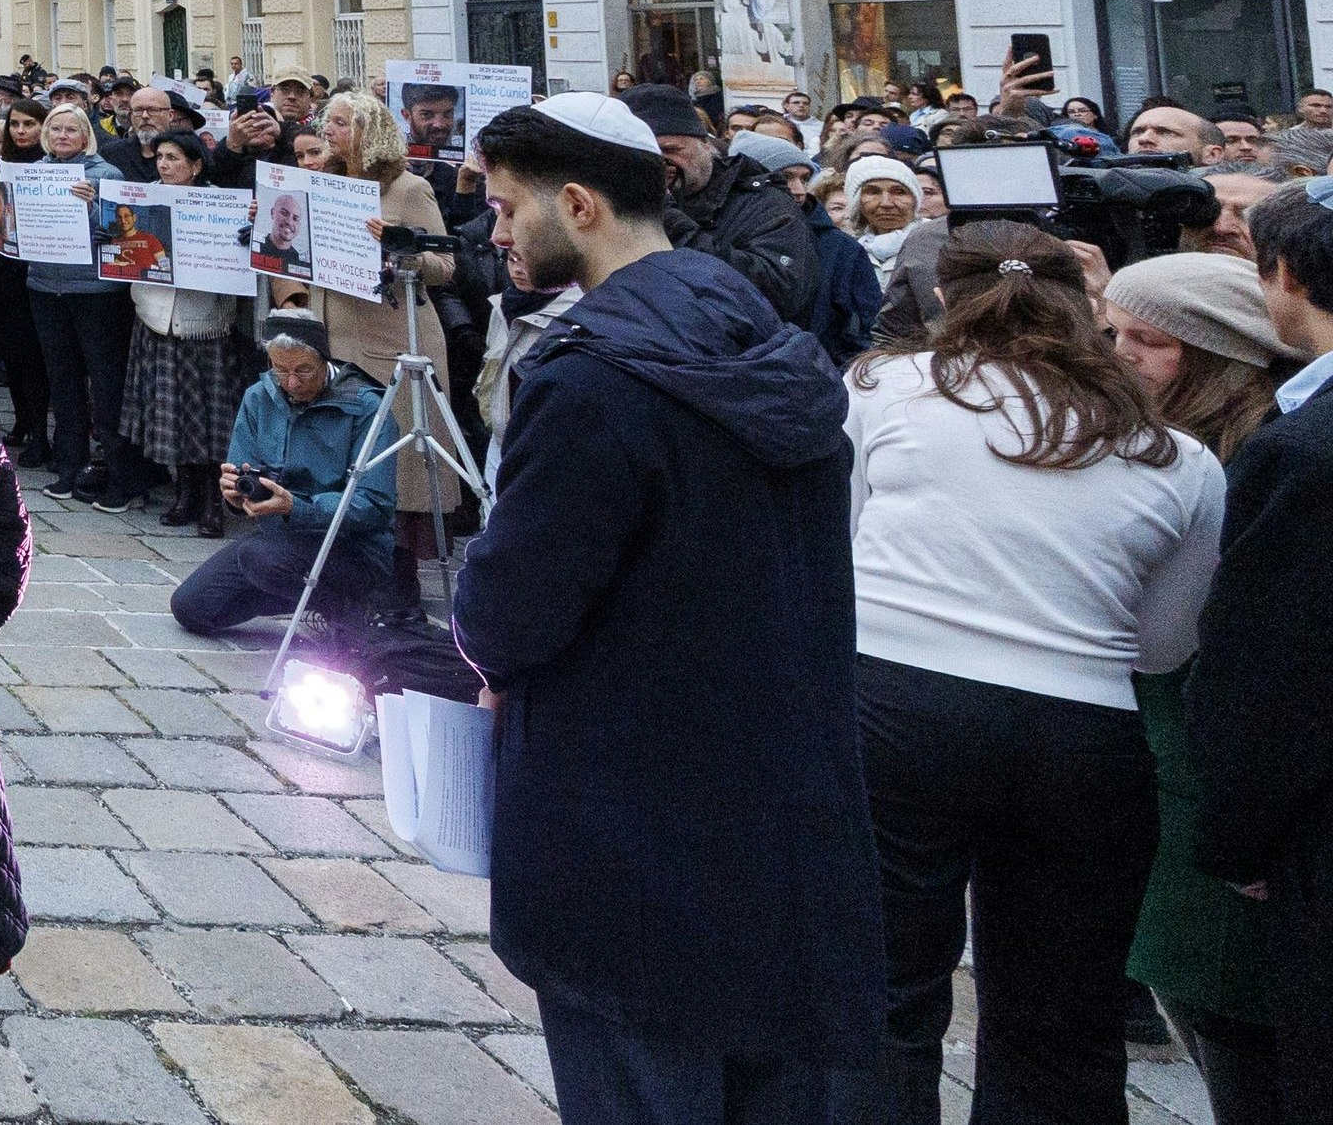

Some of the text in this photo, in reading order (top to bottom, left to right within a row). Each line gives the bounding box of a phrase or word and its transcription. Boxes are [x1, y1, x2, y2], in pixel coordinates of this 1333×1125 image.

[470, 83, 529, 99] David Cunio
[16, 183, 74, 196] Ariel Cun
[311, 175, 378, 196] BE THEIR VOICE
[203, 193, 238, 201] SCHWEIGEN
[176, 210, 204, 222] Tamir
[316, 256, 378, 282] YOUR VOICE IS
[318, 273, 333, 285] ALL
[335, 276, 355, 290] THEY
